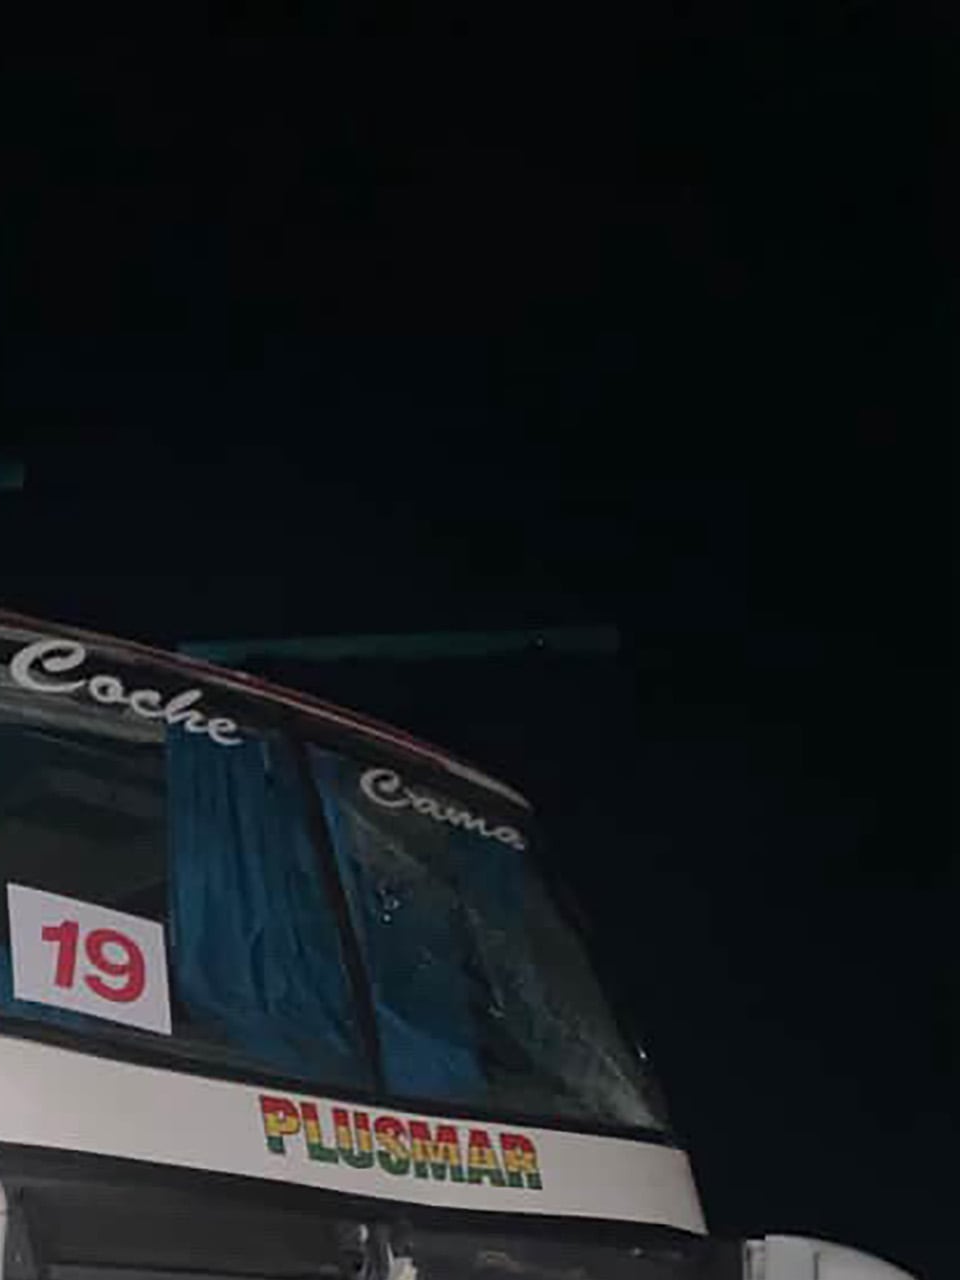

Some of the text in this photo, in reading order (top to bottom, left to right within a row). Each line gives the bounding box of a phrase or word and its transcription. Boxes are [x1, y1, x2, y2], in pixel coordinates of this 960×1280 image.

[9, 640, 526, 851] Coche Cama
[41, 919, 147, 1004] 19
[258, 1094, 543, 1190] PLUSMAR
